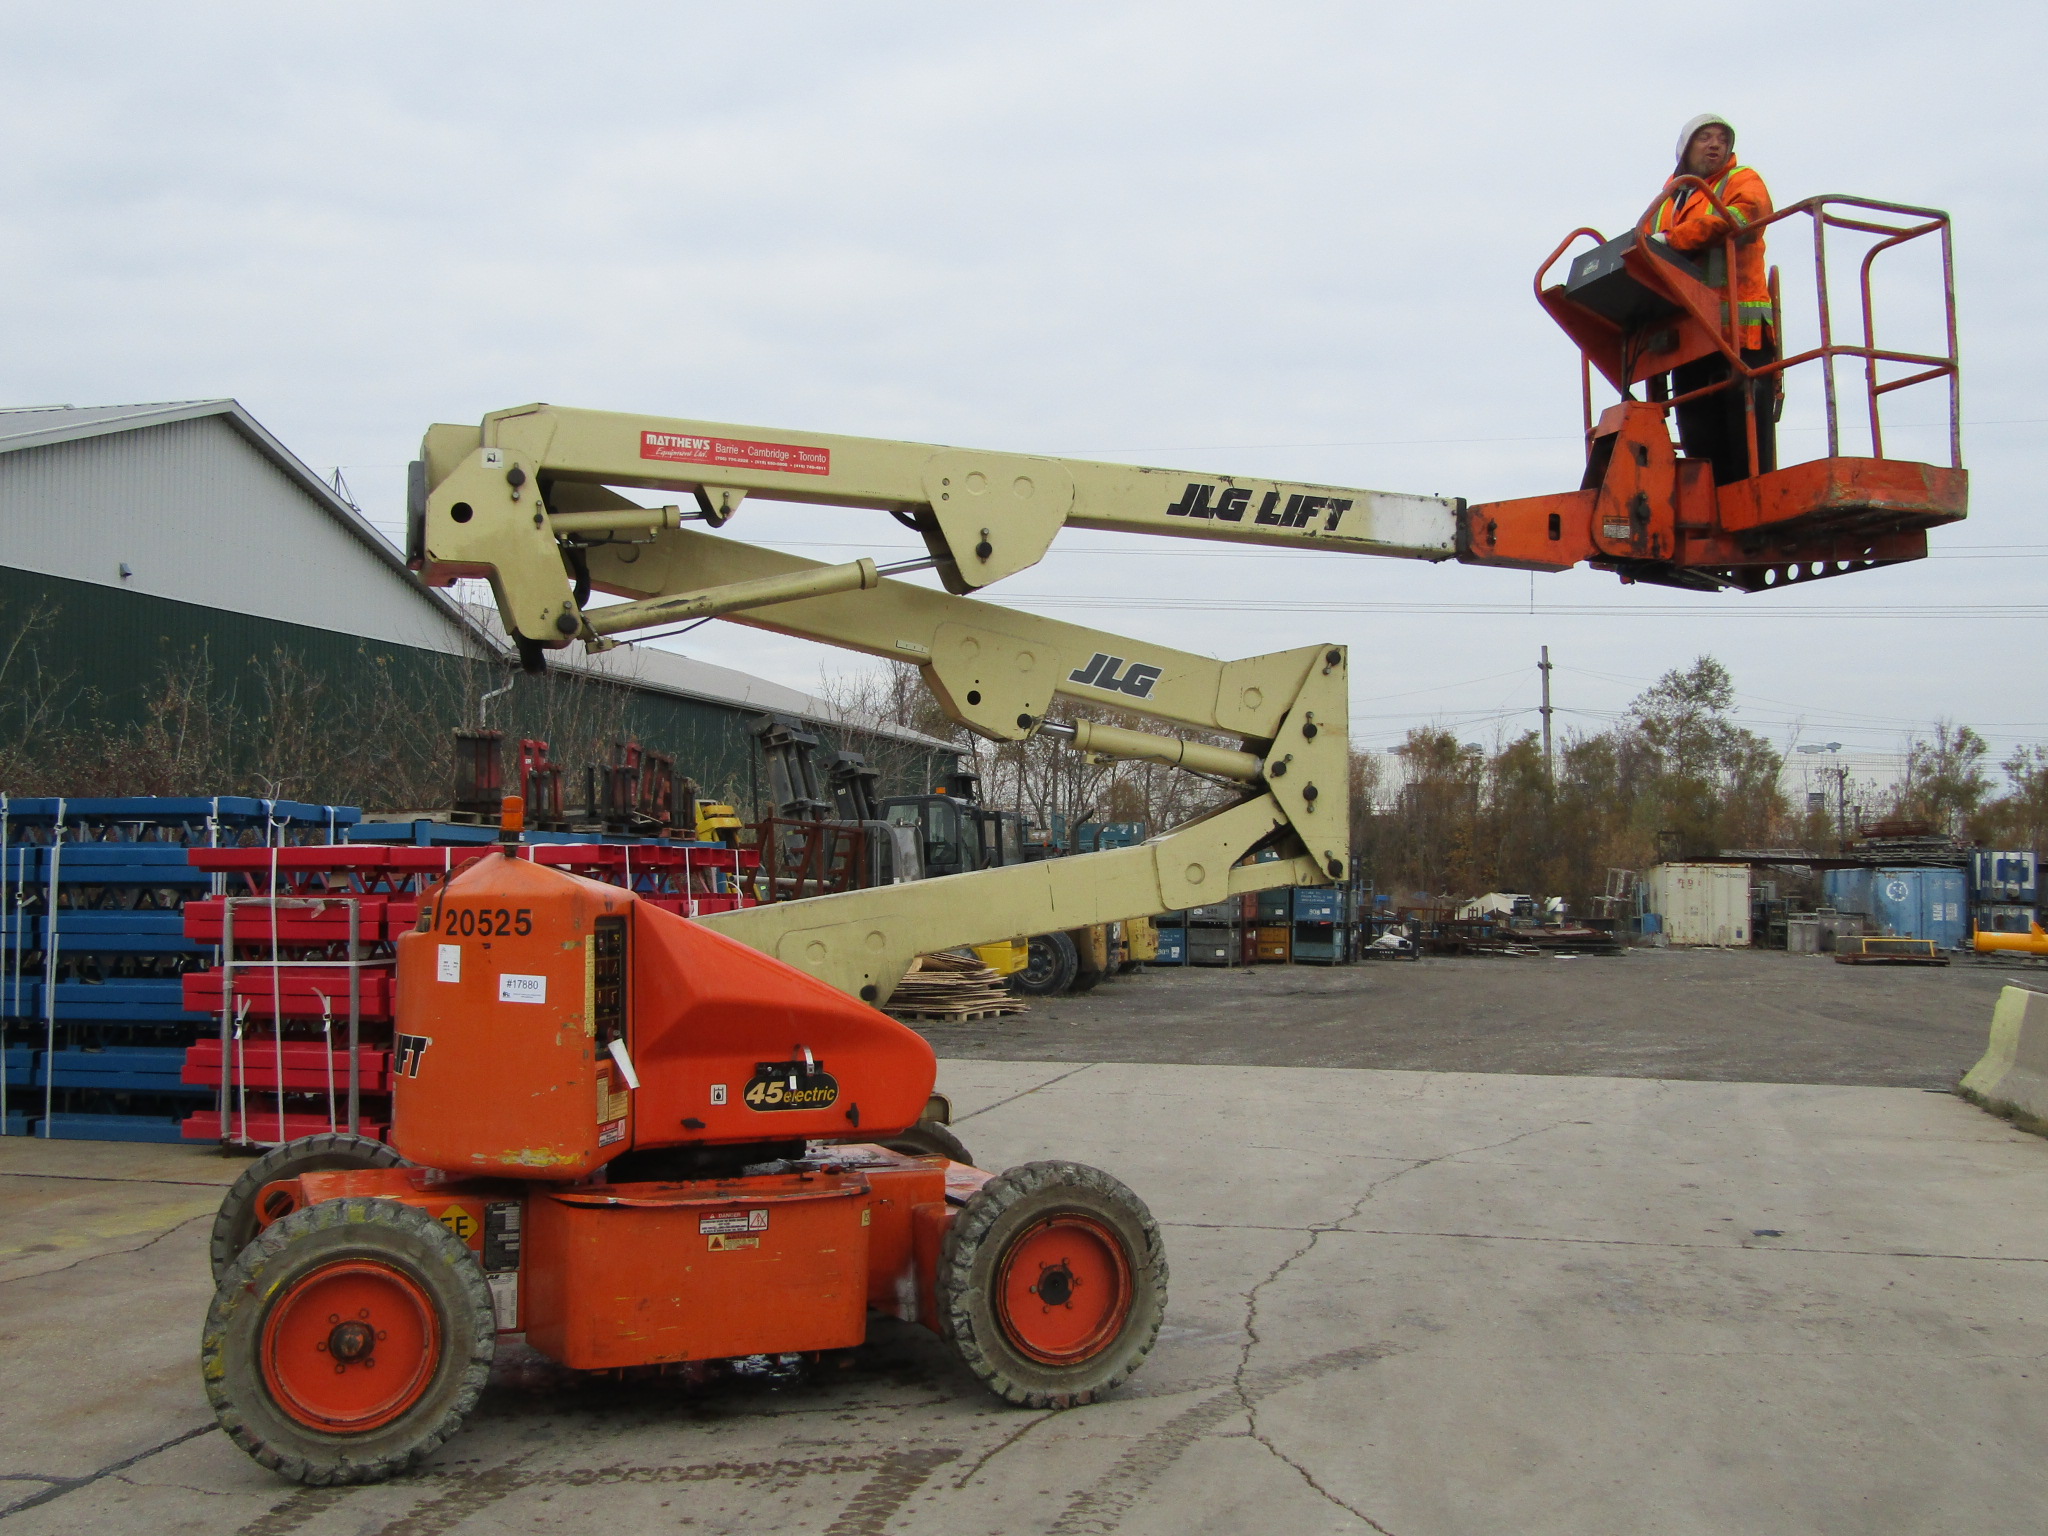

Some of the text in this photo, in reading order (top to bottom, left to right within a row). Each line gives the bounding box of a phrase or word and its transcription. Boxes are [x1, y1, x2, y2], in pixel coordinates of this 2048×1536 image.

[646, 434, 711, 450] MATTHEWS
[655, 447, 708, 458] Equipment Ltd.
[715, 443, 827, 463] Barrie Cambridge Toronto
[1166, 483, 1353, 532] JLG LIFT
[1067, 652, 1164, 698] JLG
[446, 909, 532, 937] 20525
[506, 979, 539, 990] #17880
[746, 1081, 836, 1105] 45 electric
